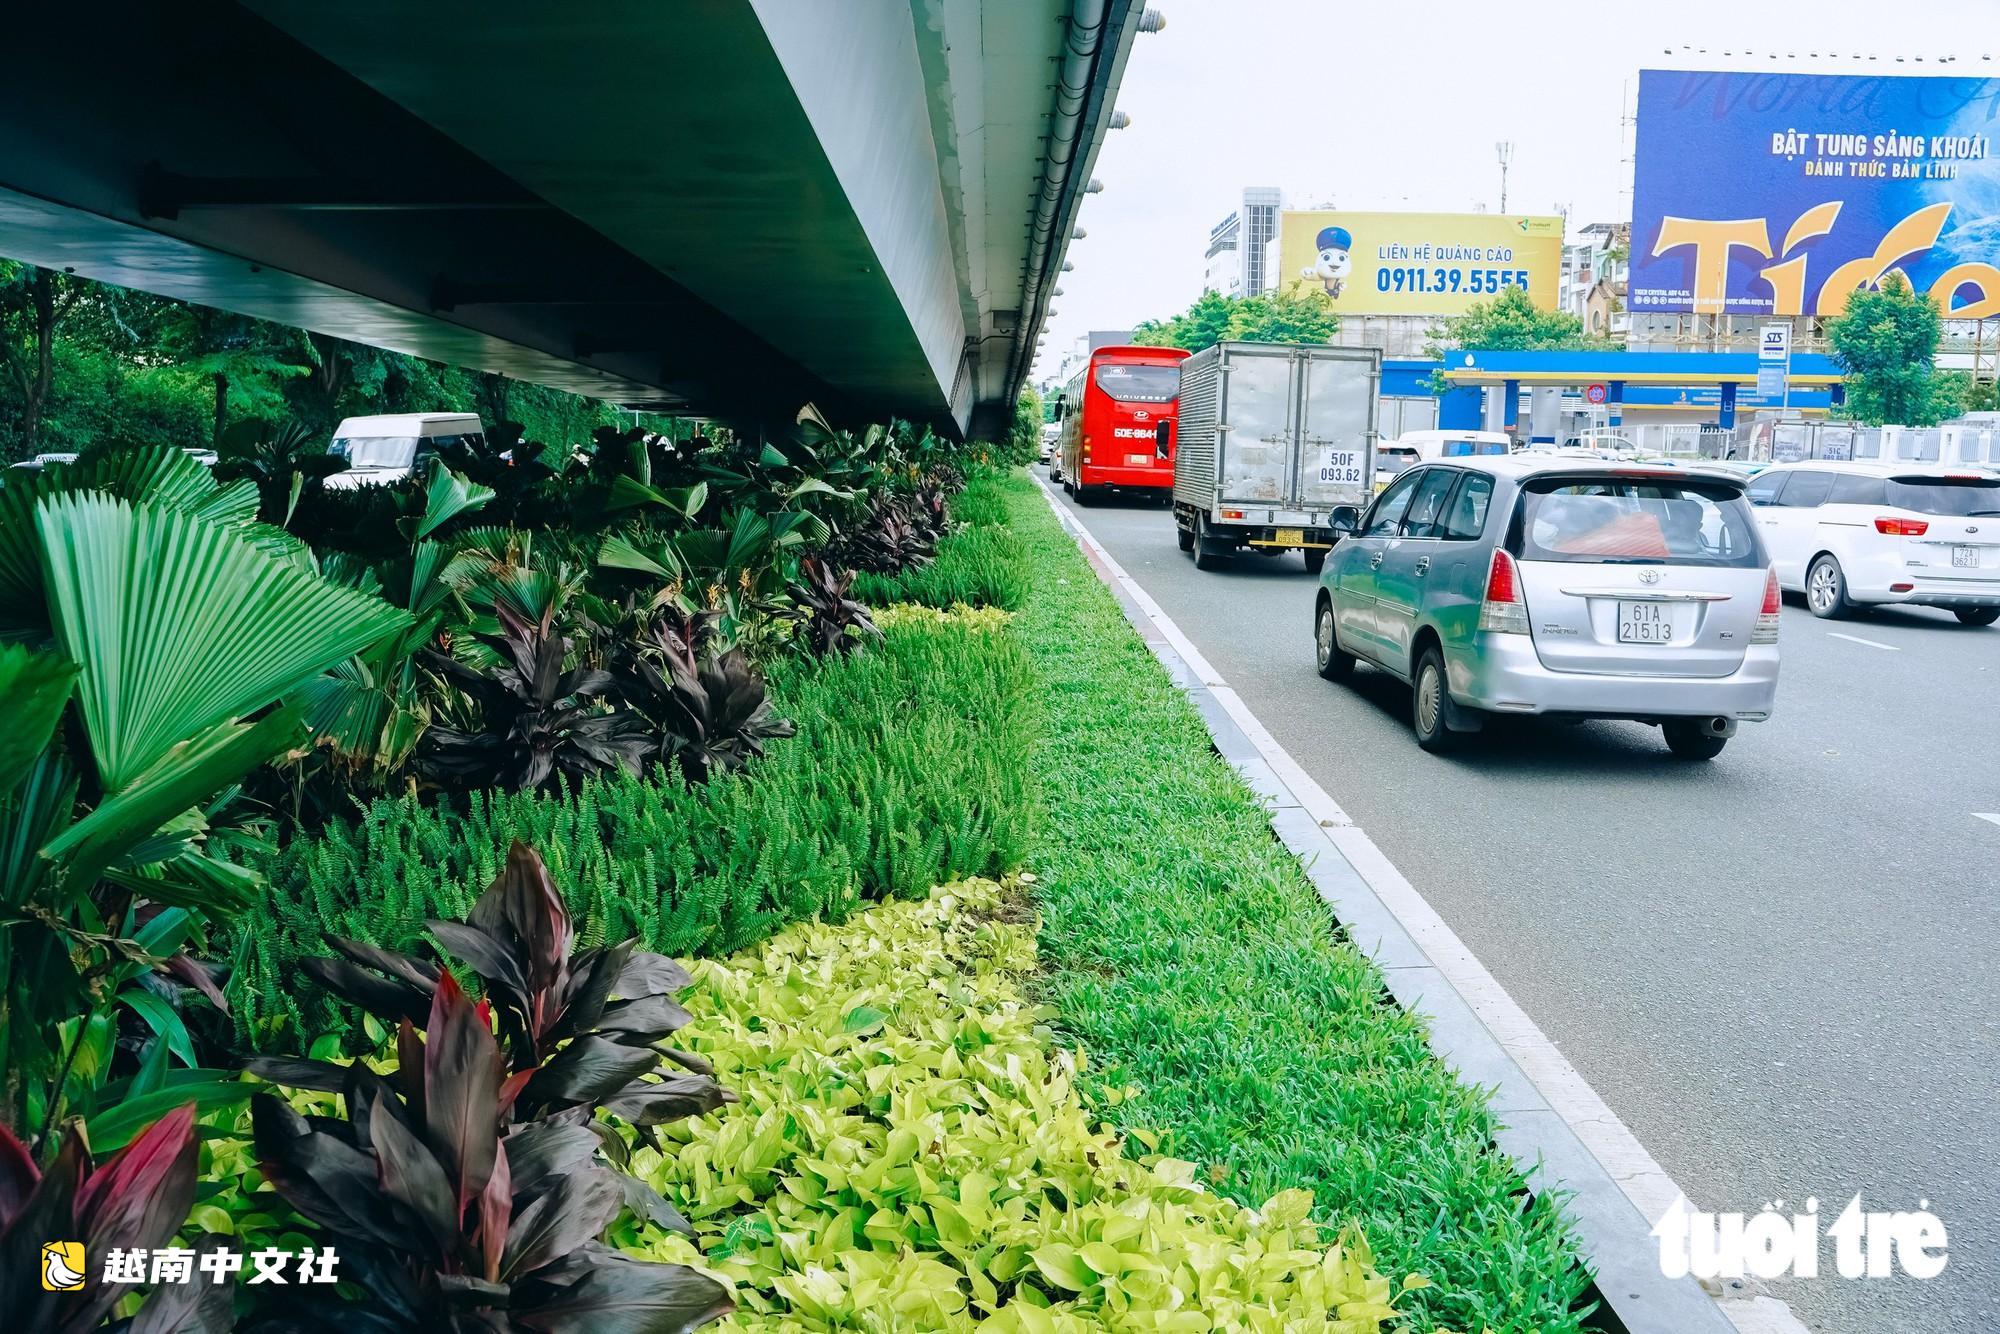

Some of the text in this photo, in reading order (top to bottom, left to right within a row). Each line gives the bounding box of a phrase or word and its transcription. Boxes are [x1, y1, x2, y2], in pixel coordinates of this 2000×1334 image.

[1772, 127, 1989, 161] BẬT TUNG SẢNG KHOÁI
[1805, 159, 1843, 178] ĐÁNH
[1850, 160, 1886, 178] THỨC
[1892, 160, 1920, 179] BẢN
[1378, 243, 1408, 260] LIÊN
[1413, 243, 1430, 264] HỆ
[1435, 244, 1481, 262] QUẢNG
[1377, 267, 1529, 294] 0911.39.5555
[1331, 452, 1354, 466] 50F
[1321, 468, 1360, 482] 093.62
[1633, 604, 1660, 622] 61A
